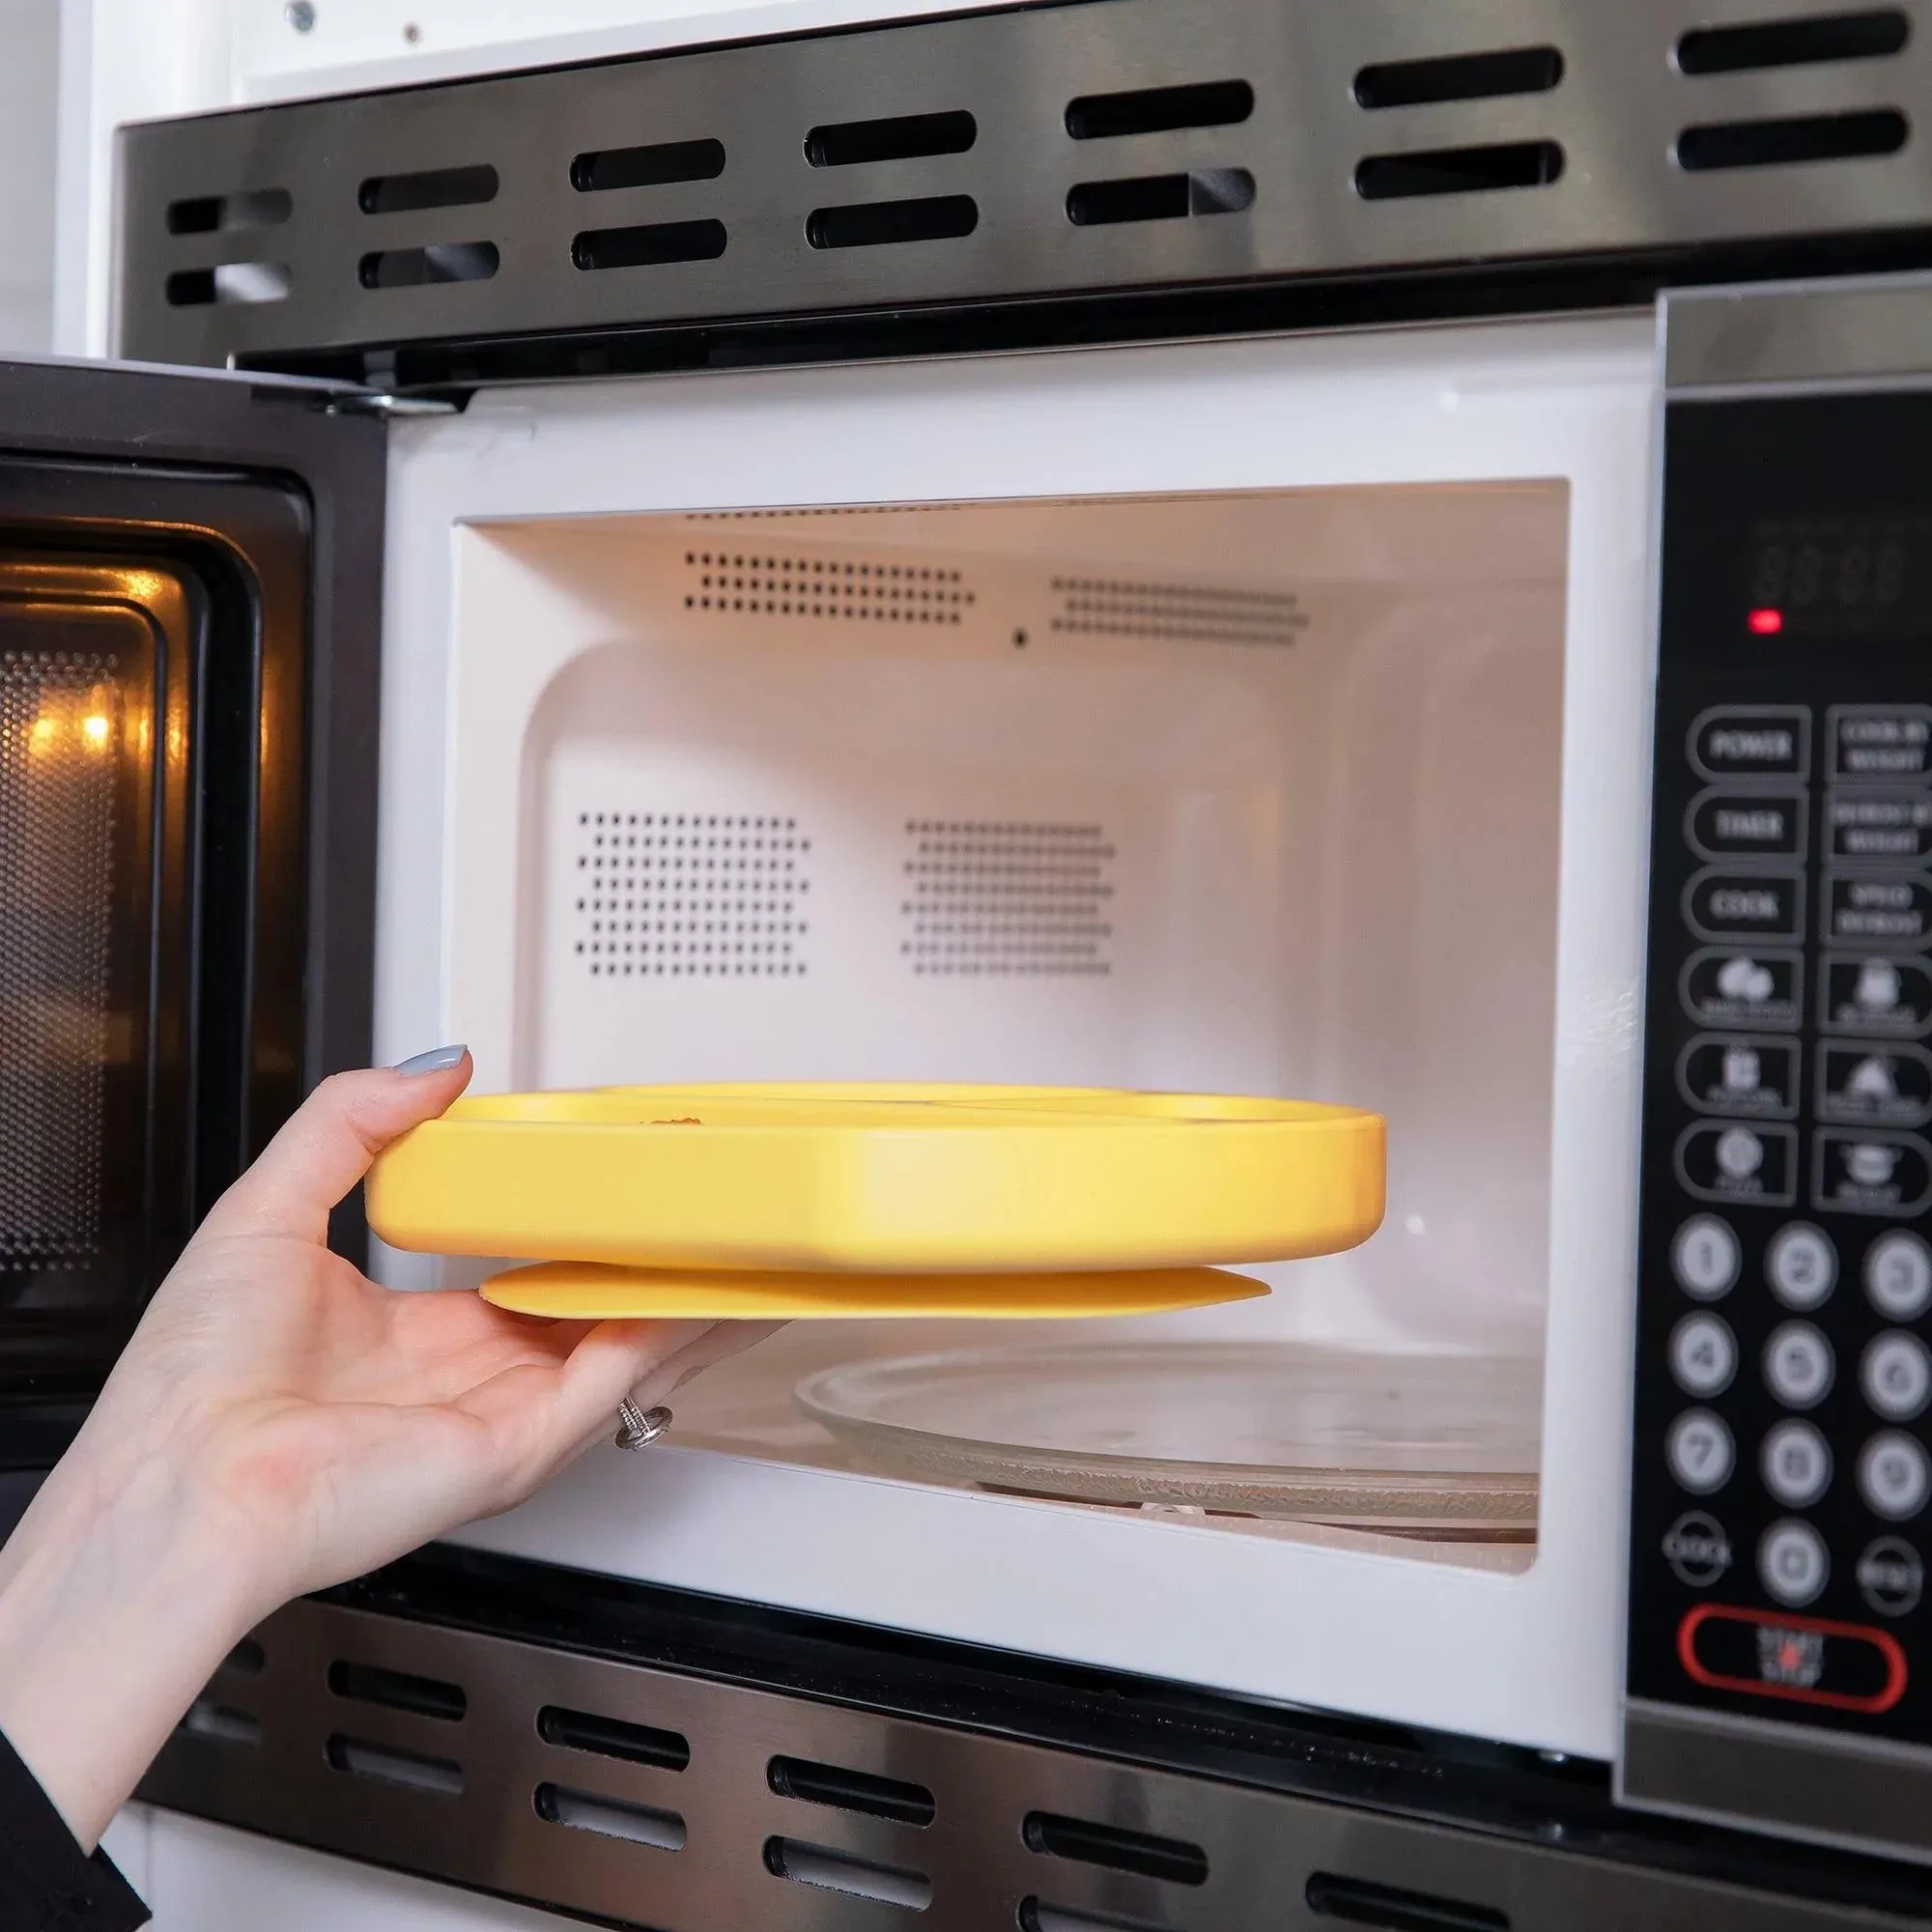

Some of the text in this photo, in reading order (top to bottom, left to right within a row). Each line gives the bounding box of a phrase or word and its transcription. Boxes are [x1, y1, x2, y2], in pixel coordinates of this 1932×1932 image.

[1709, 729, 1793, 759] POWER
[1715, 810, 1783, 840] TIMER
[1709, 890, 1779, 919] COOK
